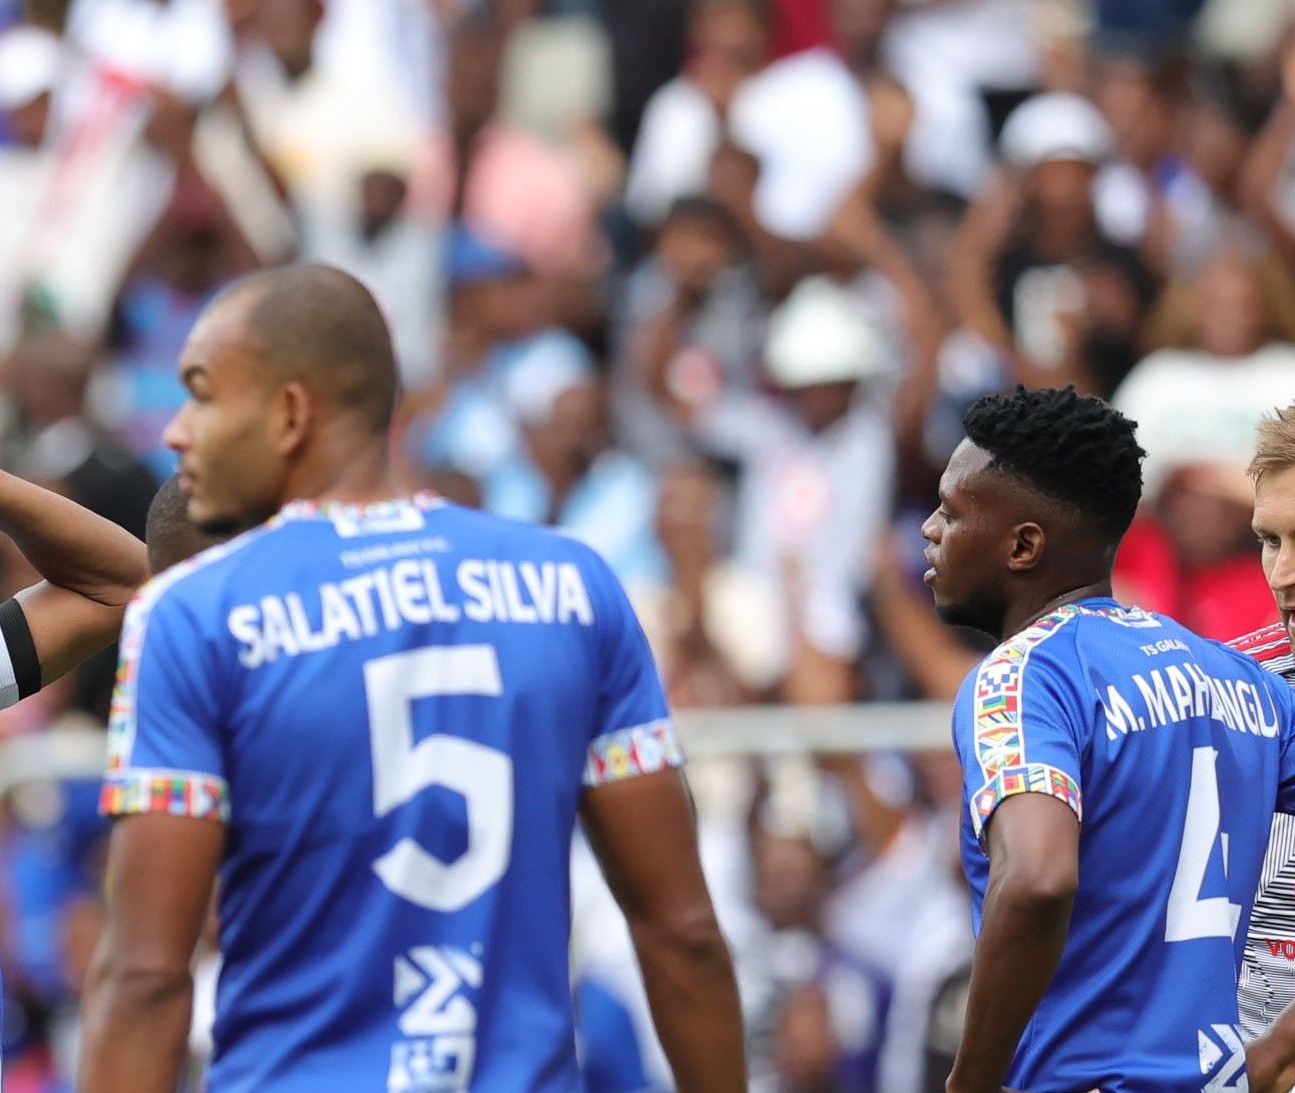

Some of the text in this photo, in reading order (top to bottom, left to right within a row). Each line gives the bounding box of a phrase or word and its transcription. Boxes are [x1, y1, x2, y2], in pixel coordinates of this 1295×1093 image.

[227, 558, 595, 669] SALATIEL SILVA
[1095, 661, 1281, 741] M. MAHANGU
[363, 643, 514, 913] 5
